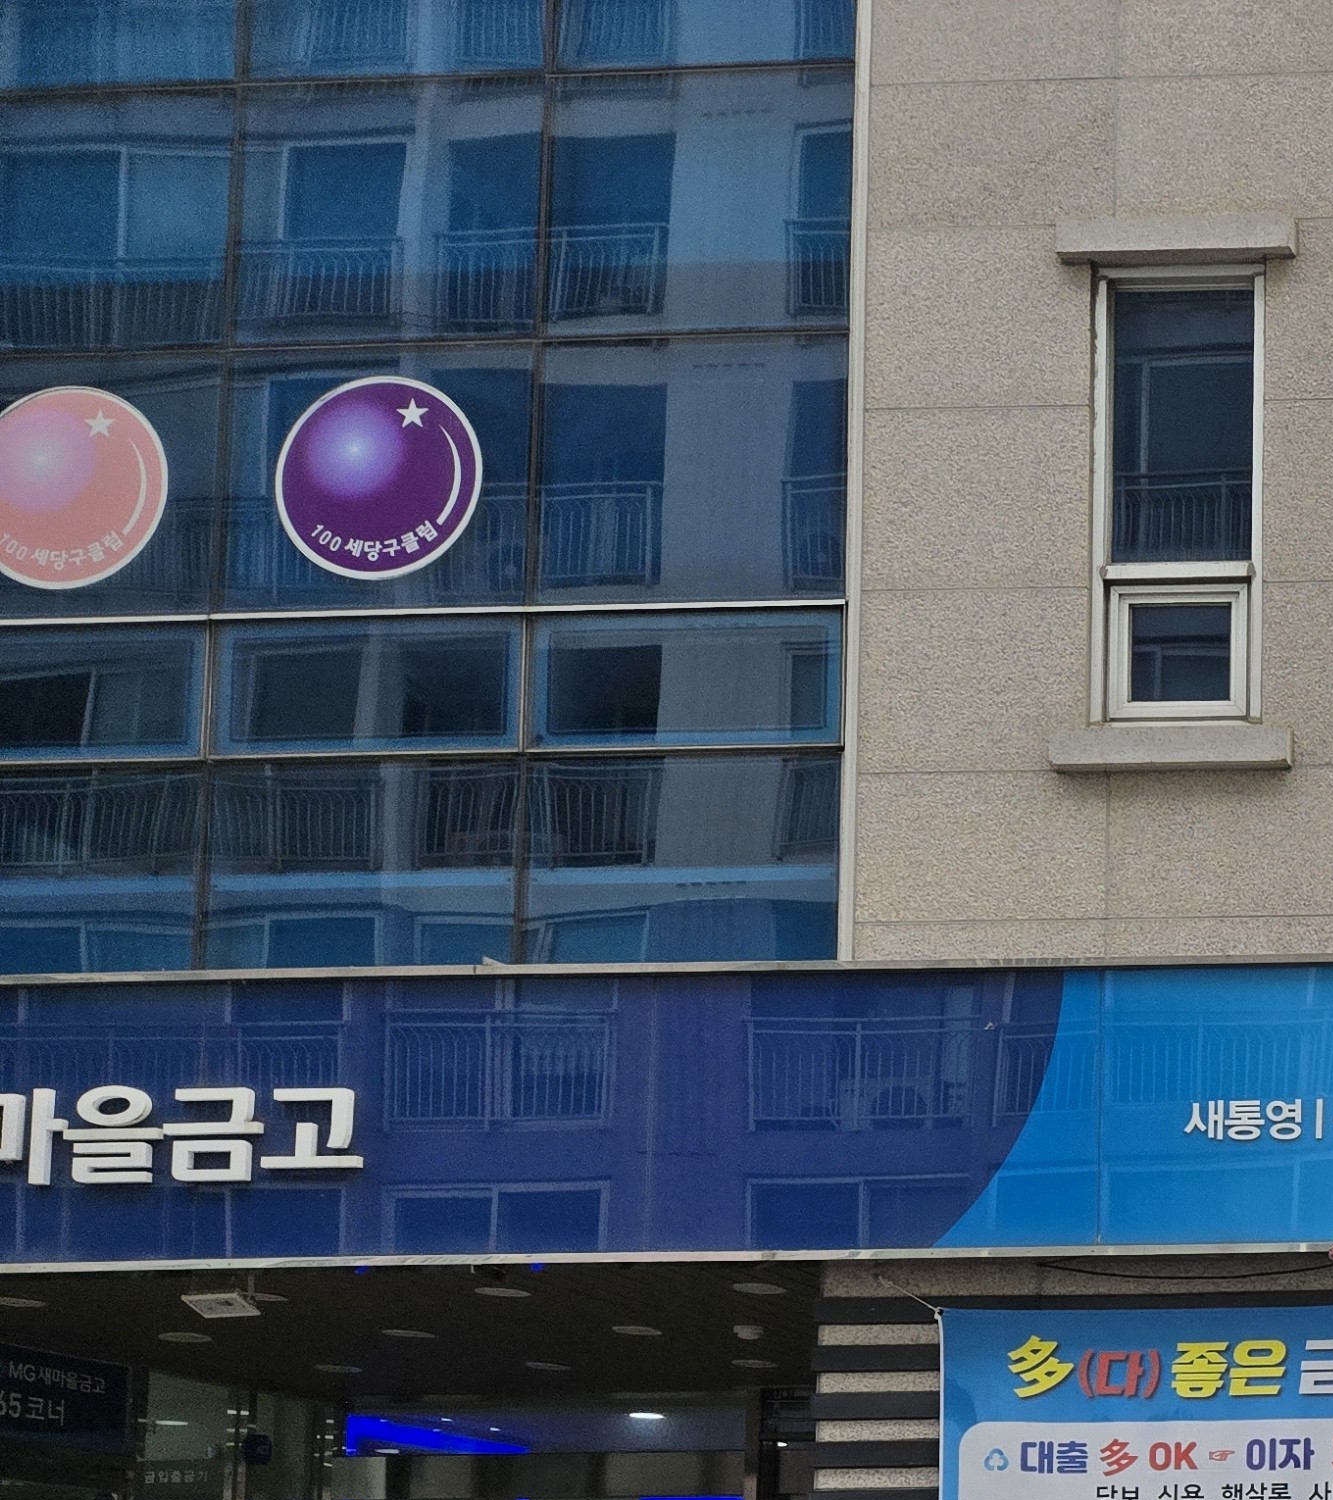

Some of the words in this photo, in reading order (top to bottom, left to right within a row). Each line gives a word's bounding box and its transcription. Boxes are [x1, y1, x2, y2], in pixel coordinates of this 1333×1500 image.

[1184, 1098, 1302, 1141] 새통영
[1171, 1338, 1288, 1398] 좋은
[1020, 1438, 1089, 1475] 대출
[1148, 1440, 1199, 1472] OK
[1245, 1436, 1315, 1472] 이자
